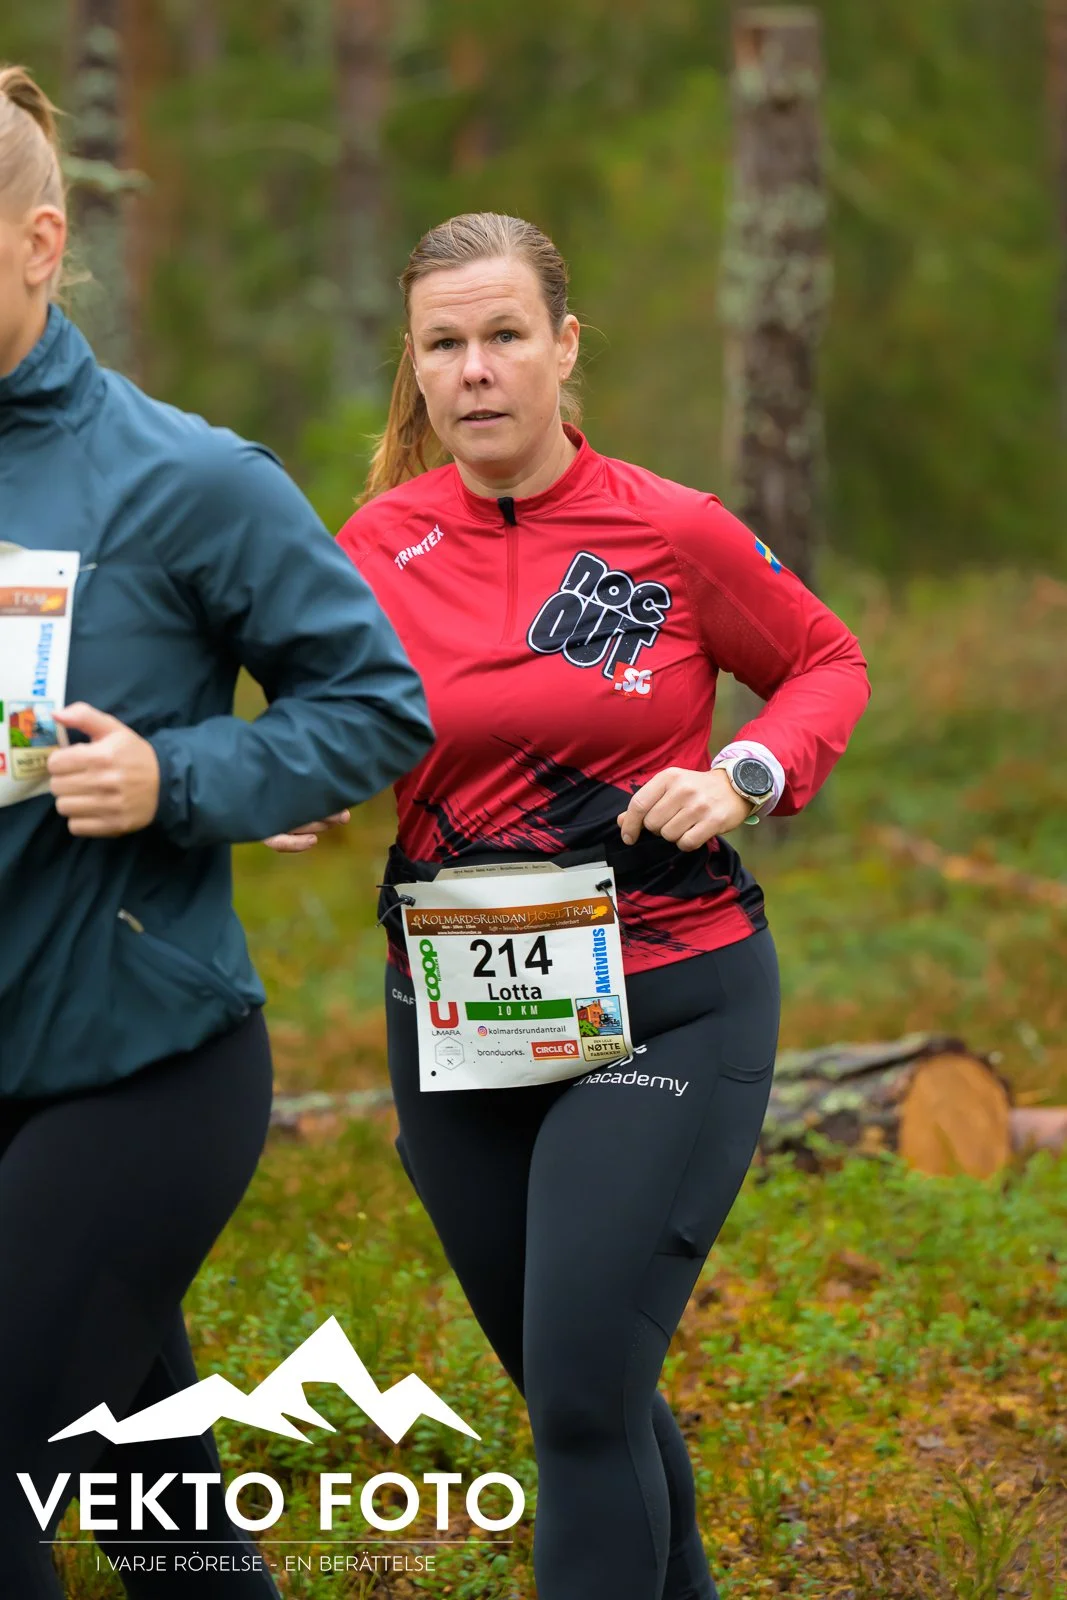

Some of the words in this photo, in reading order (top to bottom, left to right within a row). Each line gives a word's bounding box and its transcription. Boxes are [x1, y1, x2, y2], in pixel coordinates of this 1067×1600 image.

[394, 523, 445, 571] TRIMTEX
[563, 905, 595, 918] TRAIL
[470, 935, 553, 977] 214
[592, 927, 612, 994] Aktivitus
[419, 939, 441, 1001] coop
[391, 987, 417, 1006] CRAF
[488, 983, 543, 1001] Lotta
[498, 1005, 512, 1016] 10
[521, 1005, 538, 1016] KM
[488, 1026, 566, 1035] kolmardsrundantrail
[535, 1046, 563, 1054] CIRCLE
[587, 1043, 621, 1052] NØTTE
